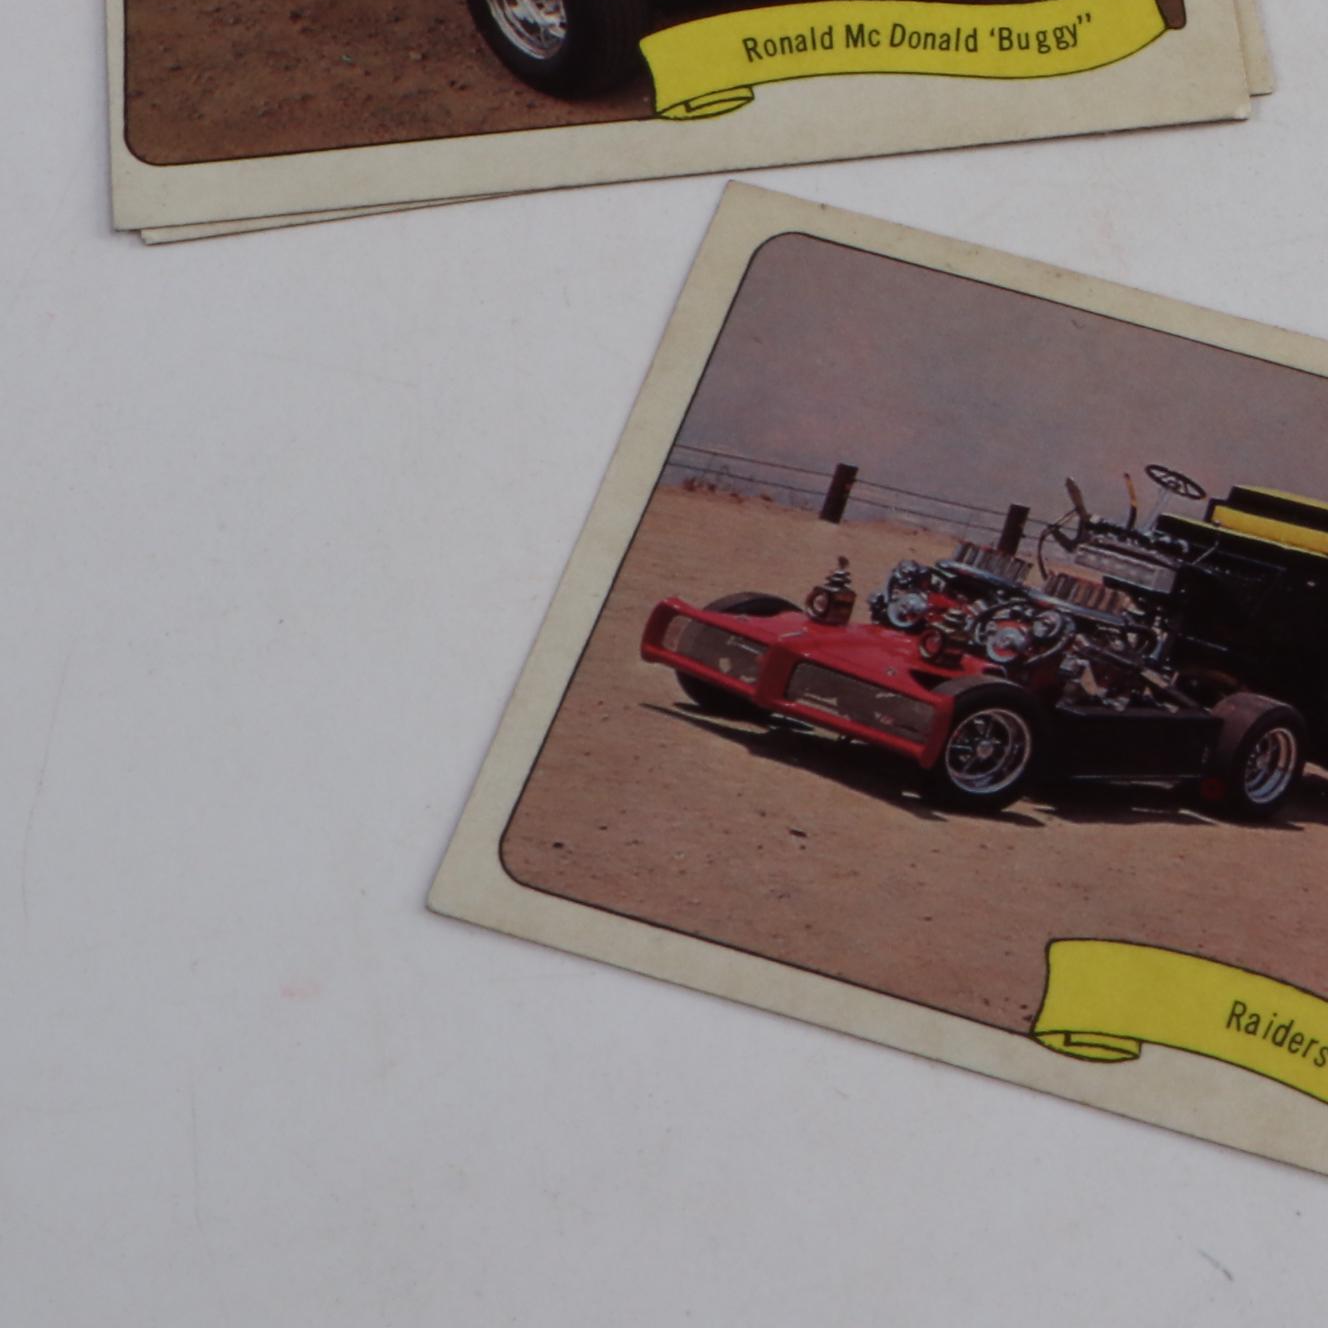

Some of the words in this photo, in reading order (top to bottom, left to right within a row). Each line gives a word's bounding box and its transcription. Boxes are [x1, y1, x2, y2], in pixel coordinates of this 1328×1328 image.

[743, 24, 835, 63] Ronald
[844, 22, 881, 49] Mc
[889, 22, 979, 53] Donald
